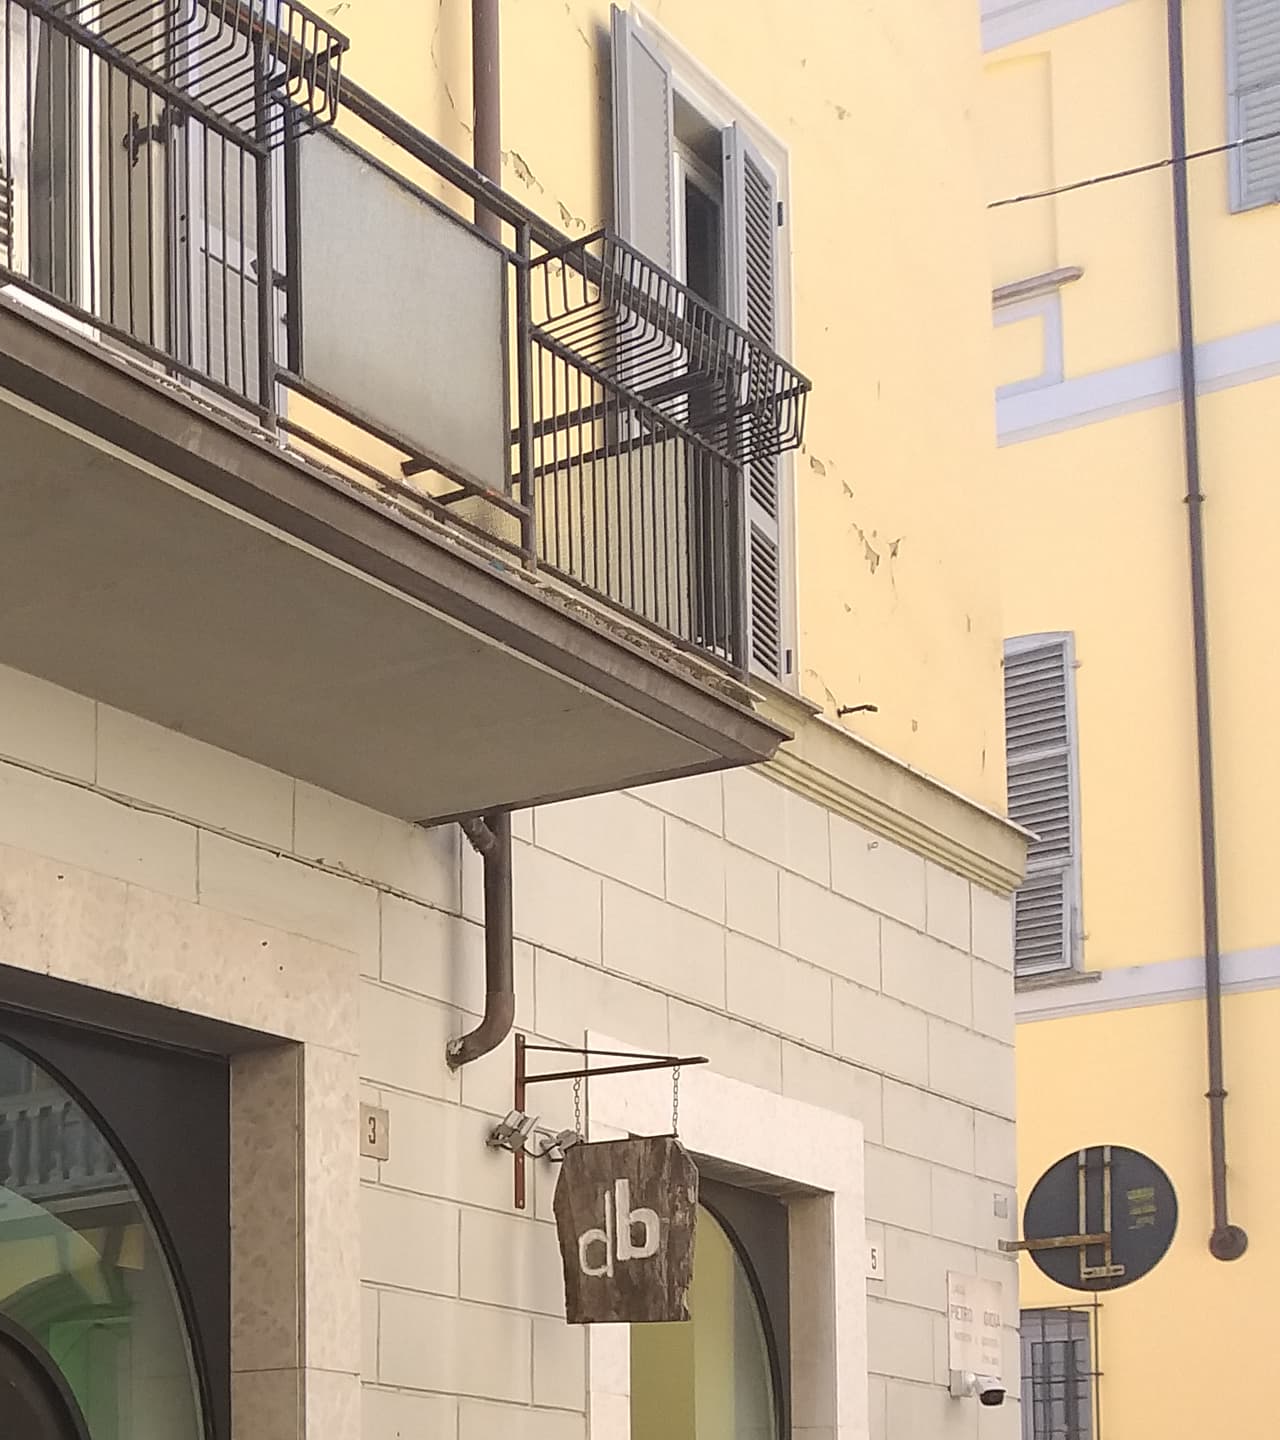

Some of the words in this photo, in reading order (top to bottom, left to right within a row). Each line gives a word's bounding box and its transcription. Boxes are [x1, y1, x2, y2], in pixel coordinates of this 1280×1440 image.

[368, 1115, 377, 1145] 3
[578, 1178, 661, 1279] db
[870, 1247, 877, 1270] 5
